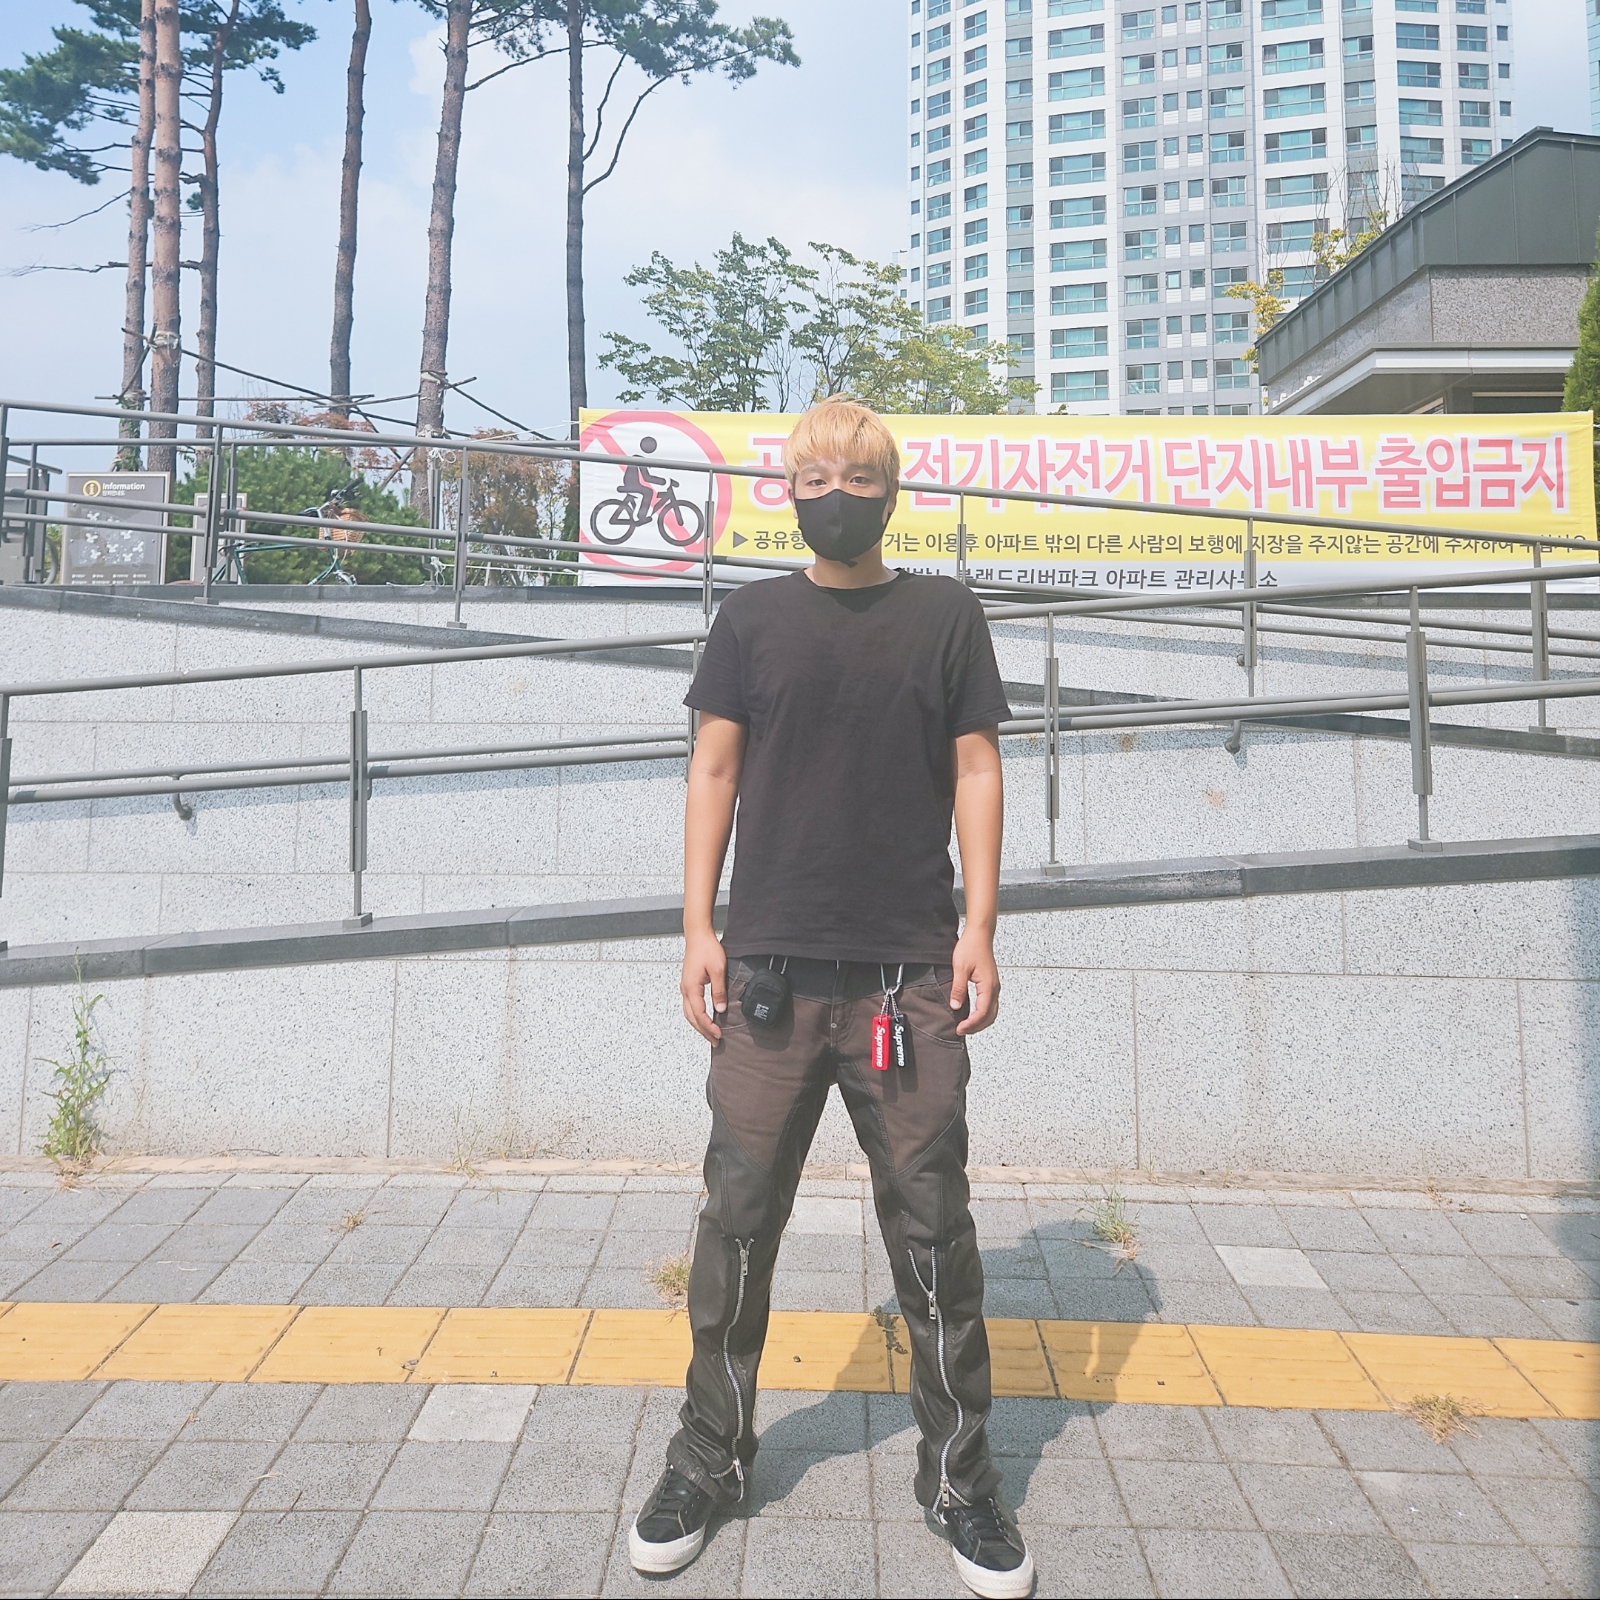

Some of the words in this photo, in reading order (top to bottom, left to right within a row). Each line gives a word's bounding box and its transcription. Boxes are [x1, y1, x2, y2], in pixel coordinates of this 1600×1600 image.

[102, 482, 146, 491] Information
[747, 438, 788, 506] 공
[904, 438, 1151, 508] 전기자전거
[1164, 439, 1368, 509] 단지내부
[1375, 437, 1564, 508] 출입금지
[884, 532, 920, 552] 거는
[985, 533, 1040, 553] 아파트
[1045, 534, 1081, 553] 밖의
[1087, 534, 1123, 553] 다른
[1127, 534, 1182, 554] 사람의
[1188, 534, 1243, 554] 보행에
[1251, 534, 1304, 554] 지장을
[1308, 535, 1382, 554] 주지않는
[1386, 535, 1439, 554] 공간에
[1106, 569, 1168, 589] 아파트
[1174, 569, 1278, 589] 관리사소
[874, 1025, 886, 1068] Supreme
[892, 1024, 905, 1067] Supreme
